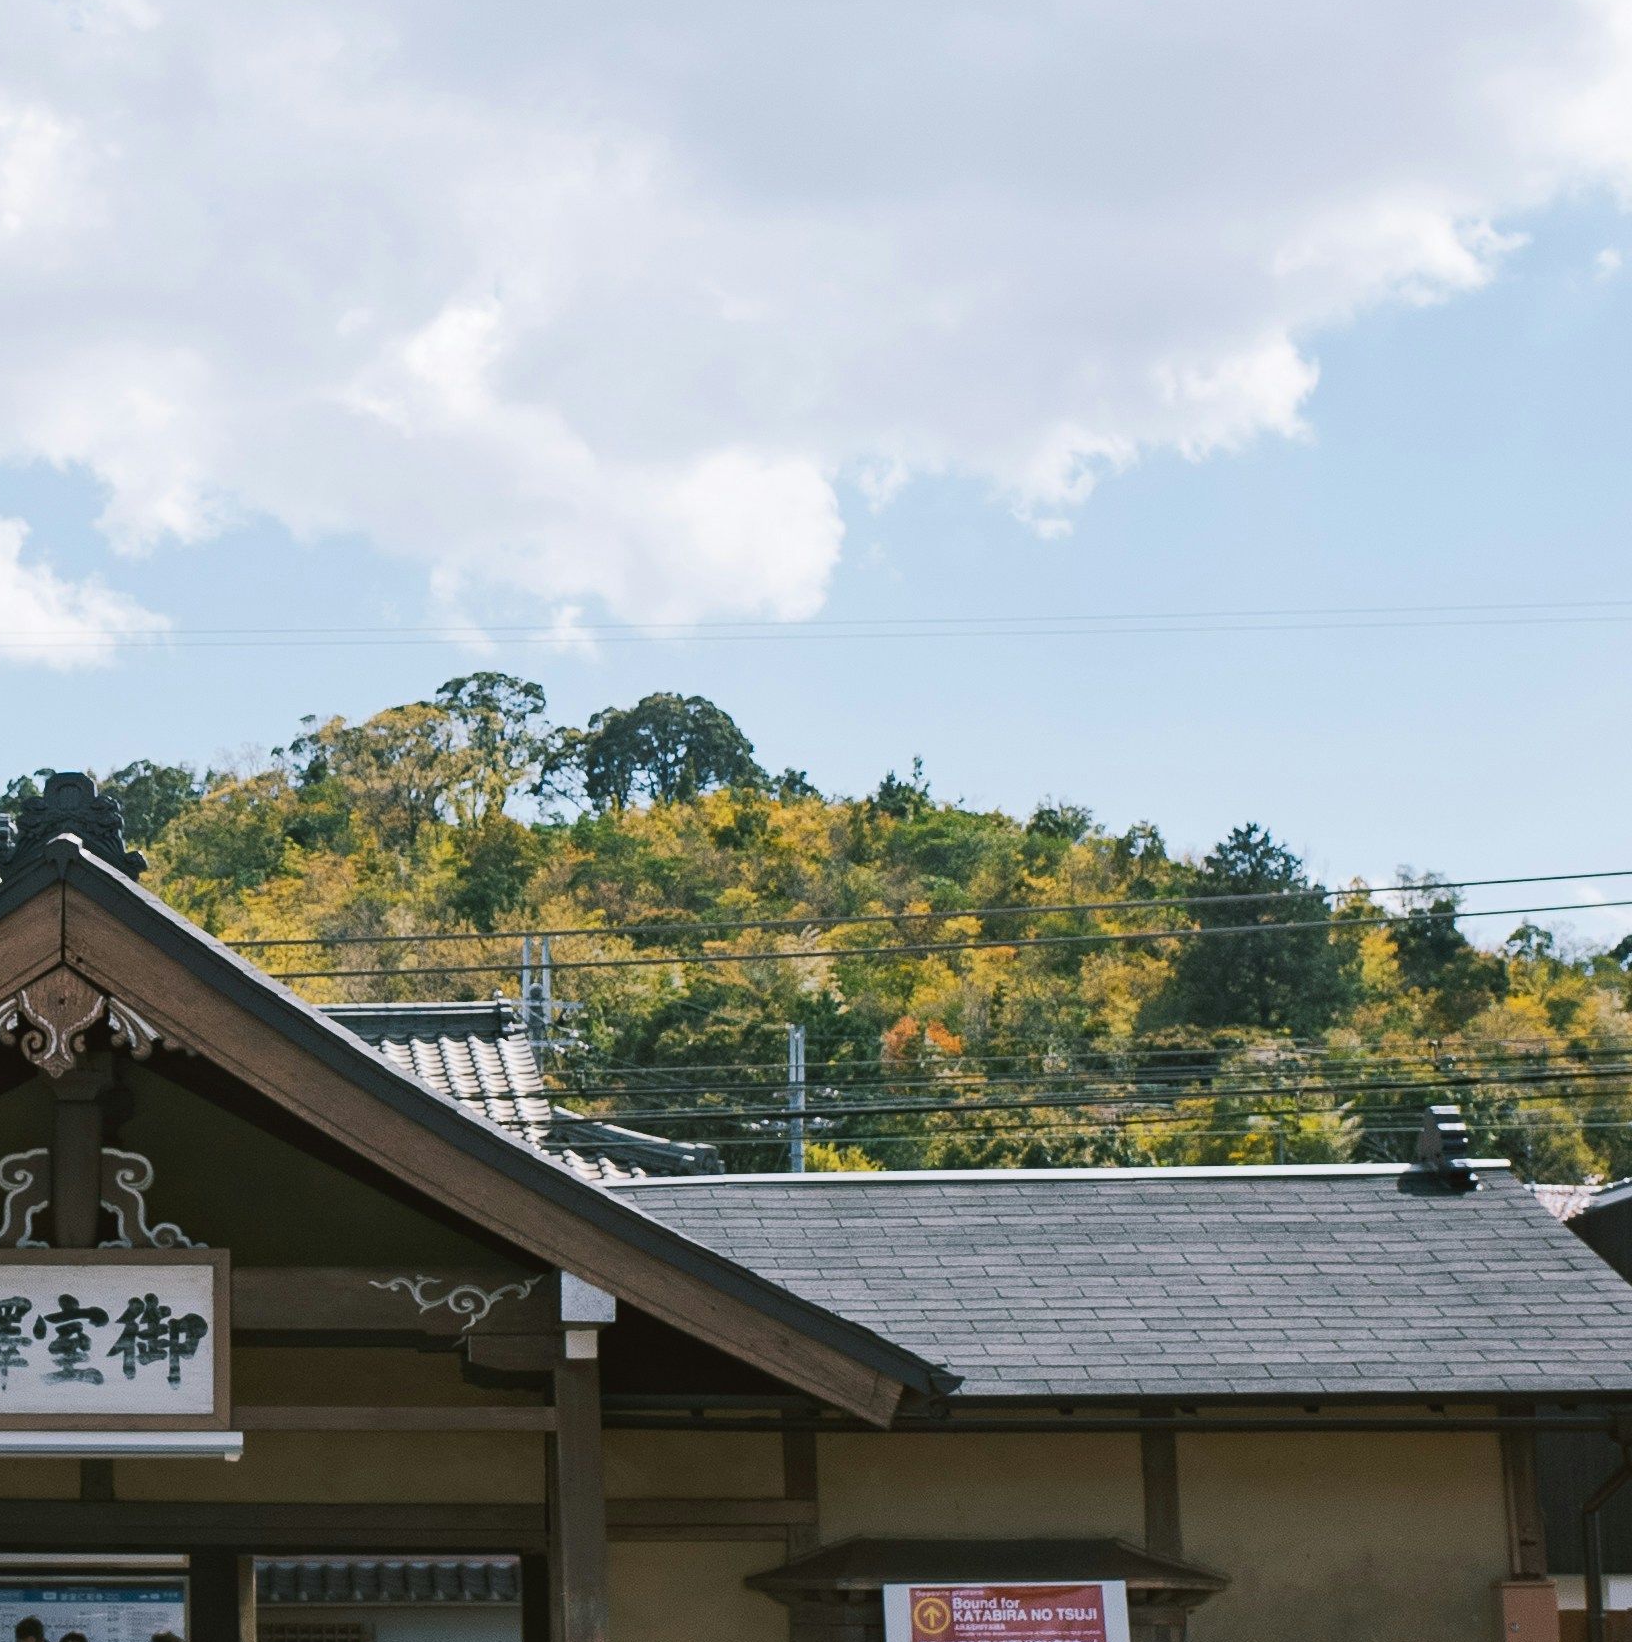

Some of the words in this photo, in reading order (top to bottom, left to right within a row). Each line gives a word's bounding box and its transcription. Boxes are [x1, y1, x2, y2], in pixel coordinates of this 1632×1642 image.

[952, 1598, 996, 1609] Bound
[999, 1598, 1020, 1609] for
[953, 1608, 1027, 1622] KATABIRA
[1031, 1608, 1053, 1621] NO
[1056, 1607, 1098, 1621] TSUJI
